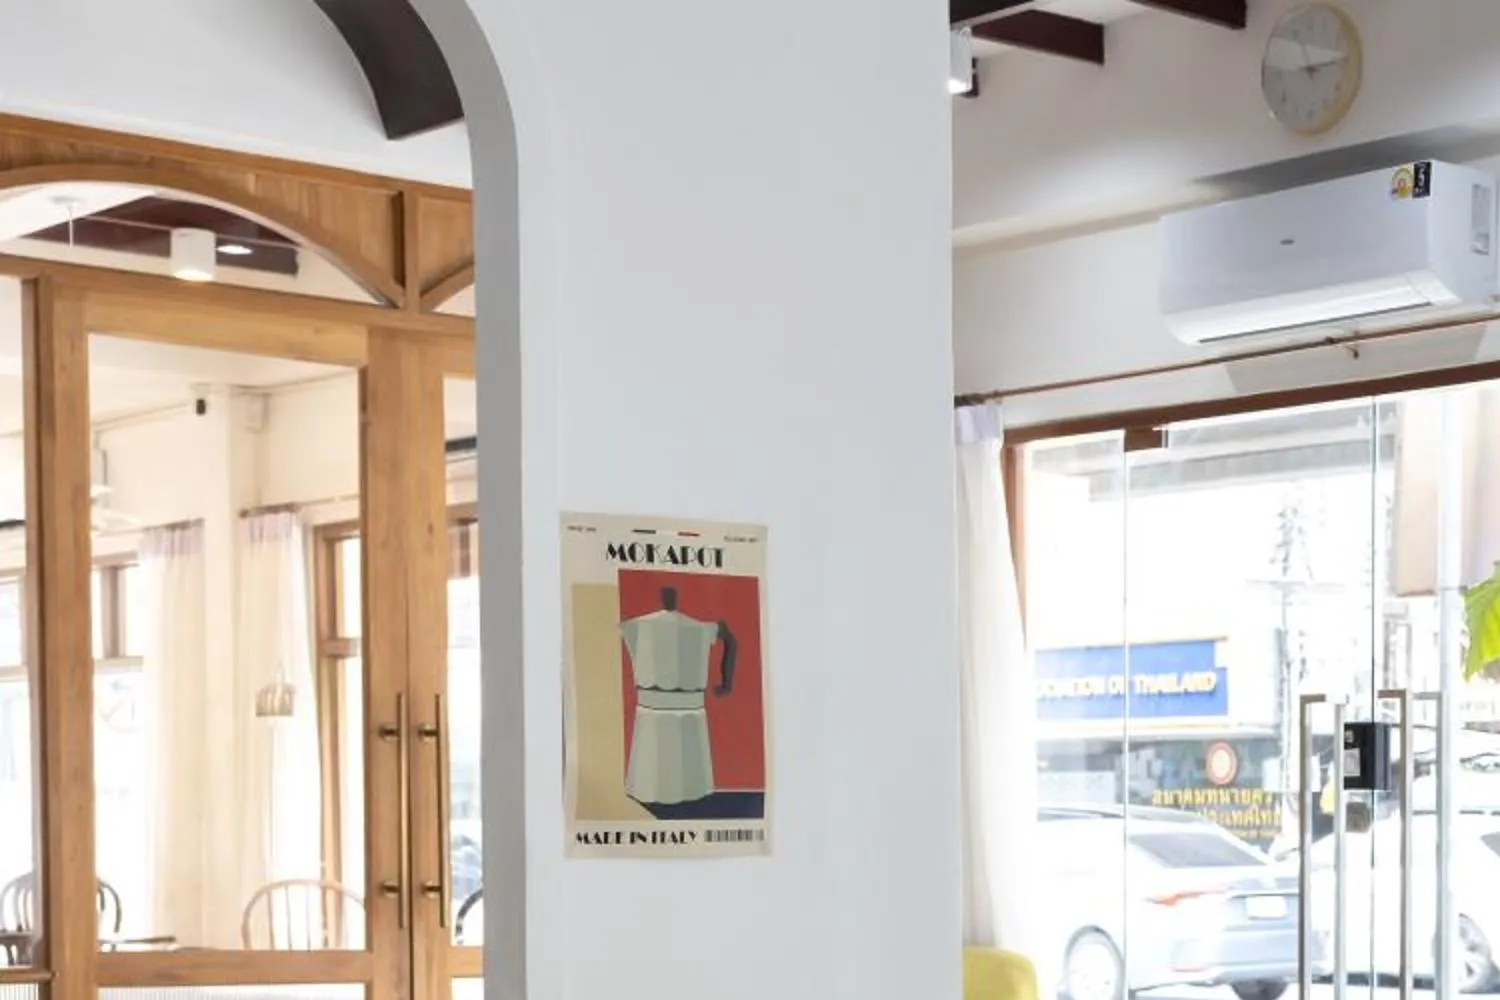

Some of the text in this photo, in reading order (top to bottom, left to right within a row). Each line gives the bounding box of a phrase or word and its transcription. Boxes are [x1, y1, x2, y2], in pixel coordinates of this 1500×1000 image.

[606, 541, 724, 568] MOKAPOT
[1133, 672, 1216, 693] THAILAND
[575, 830, 698, 845] MADE IN ITALY
